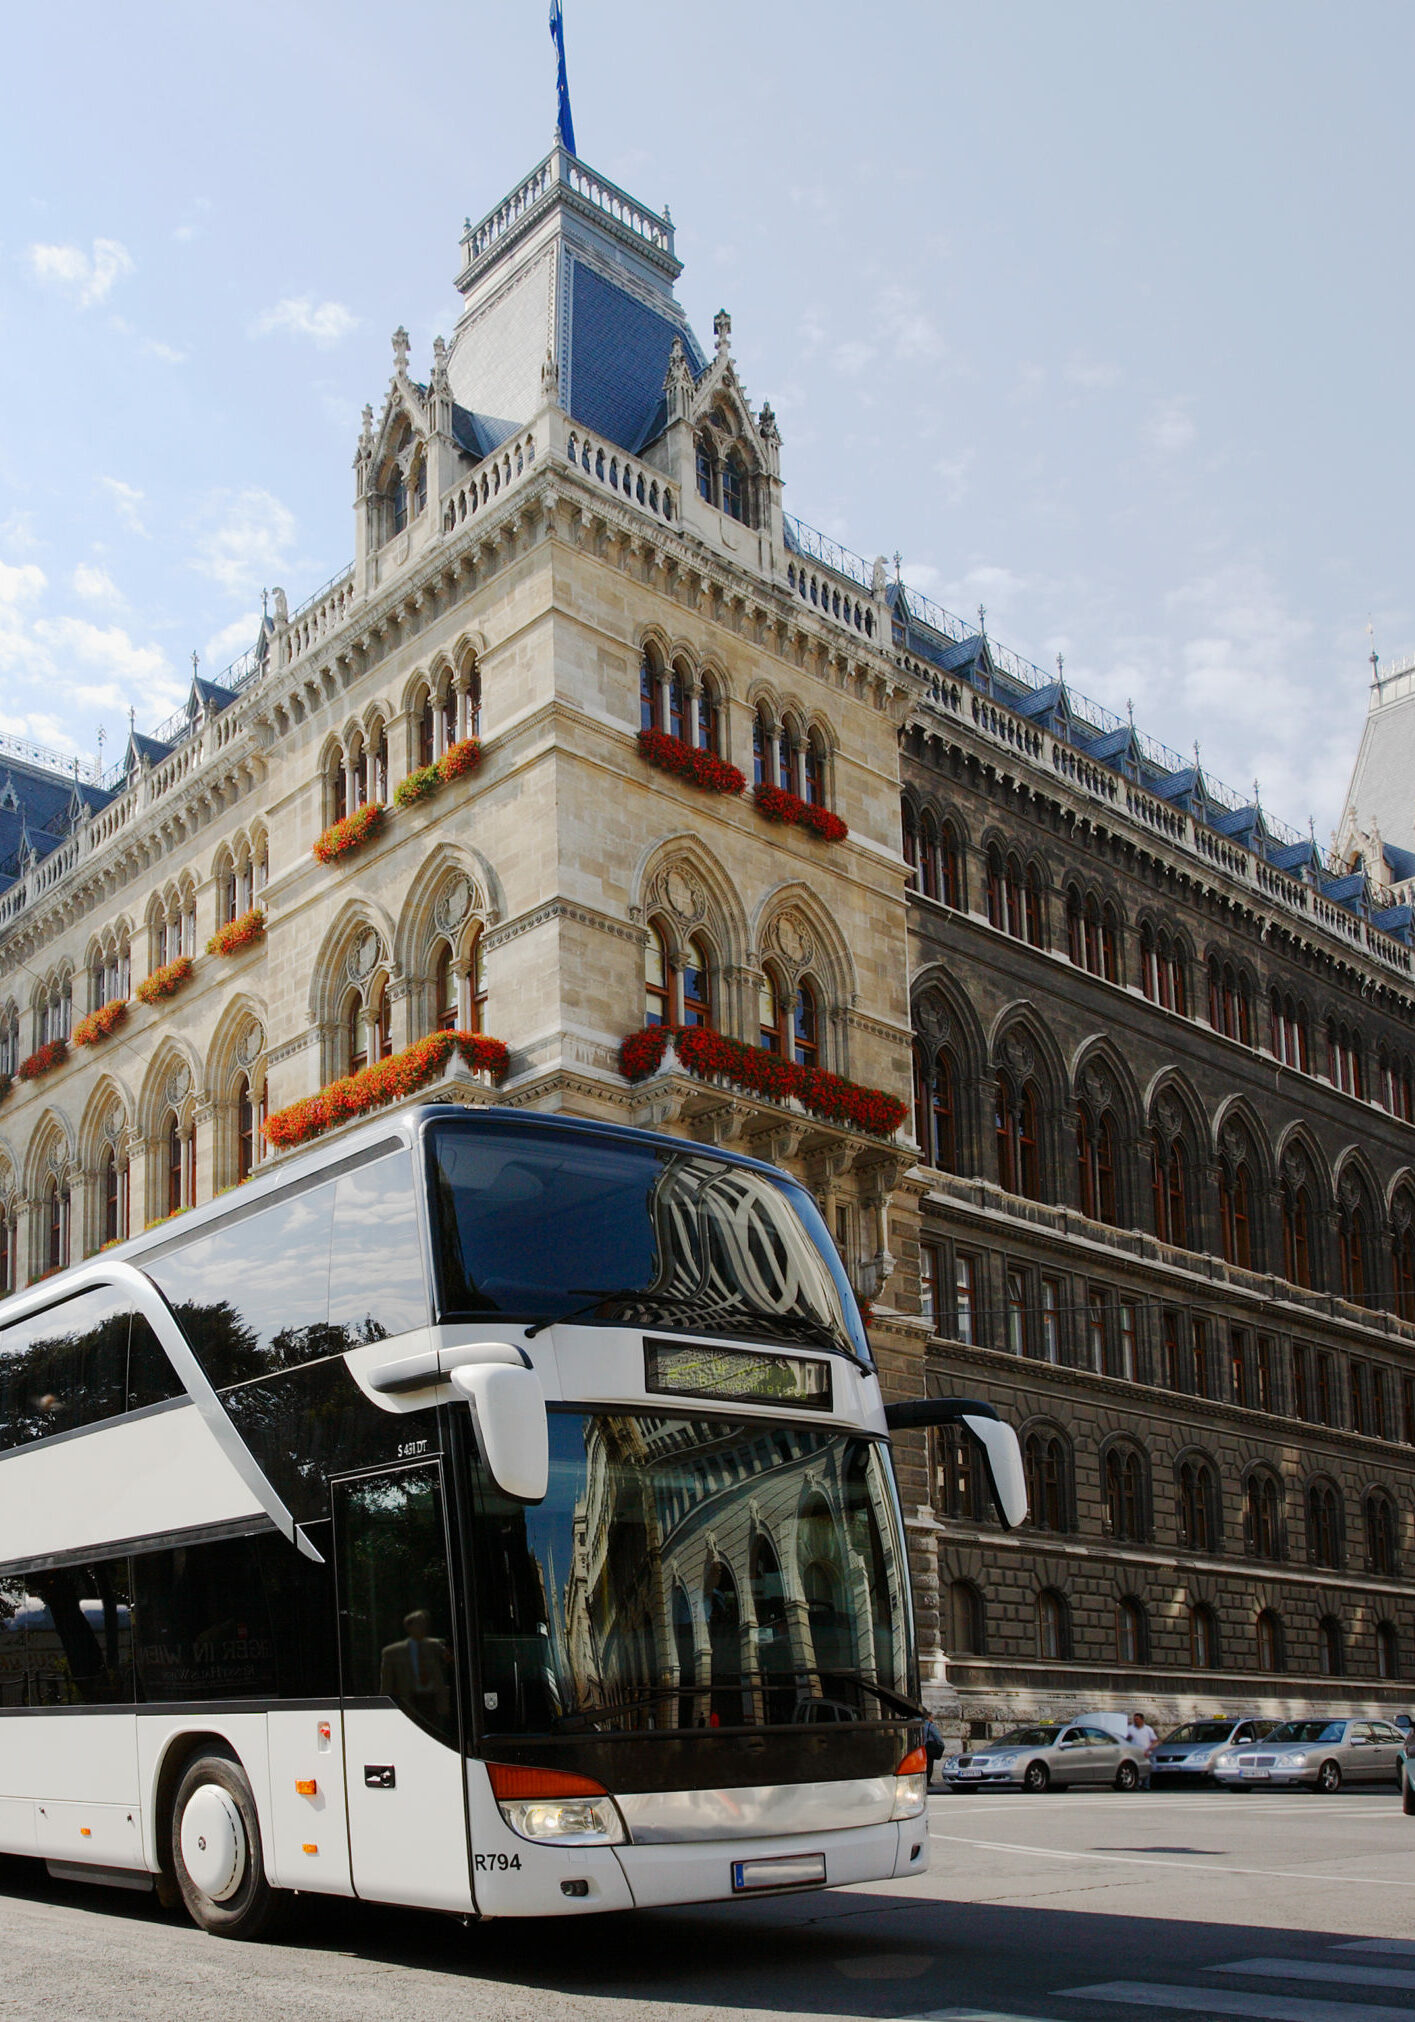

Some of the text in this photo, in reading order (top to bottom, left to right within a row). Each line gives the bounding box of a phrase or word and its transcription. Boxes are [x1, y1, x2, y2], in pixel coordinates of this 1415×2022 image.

[397, 1440, 428, 1457] S 431 DT
[474, 1853, 522, 1871] R794
